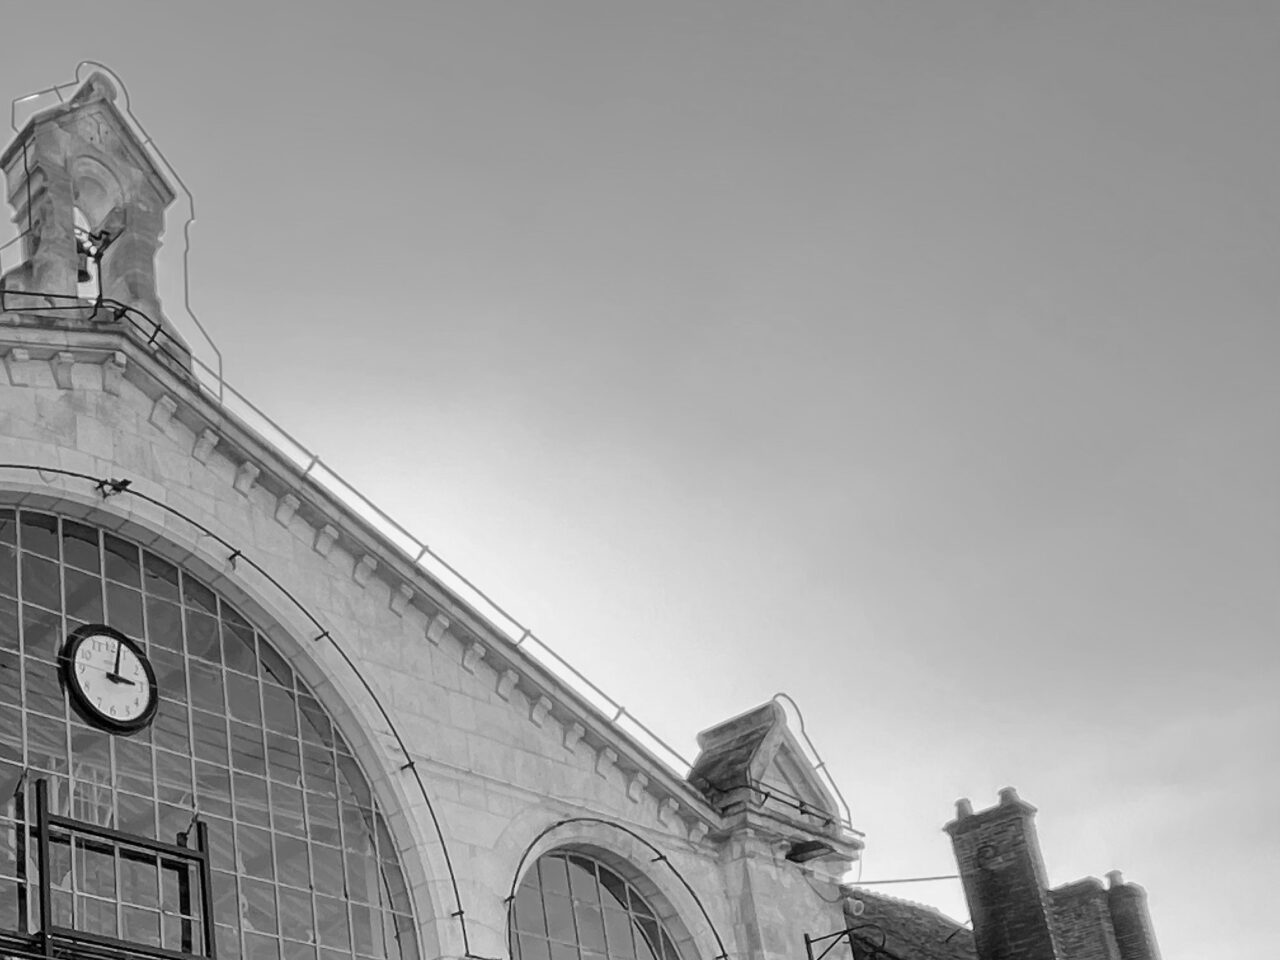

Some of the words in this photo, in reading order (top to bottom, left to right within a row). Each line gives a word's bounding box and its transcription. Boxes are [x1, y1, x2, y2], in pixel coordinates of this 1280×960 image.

[105, 641, 116, 653] 12
[81, 649, 92, 660] 10
[109, 705, 117, 715] 6
